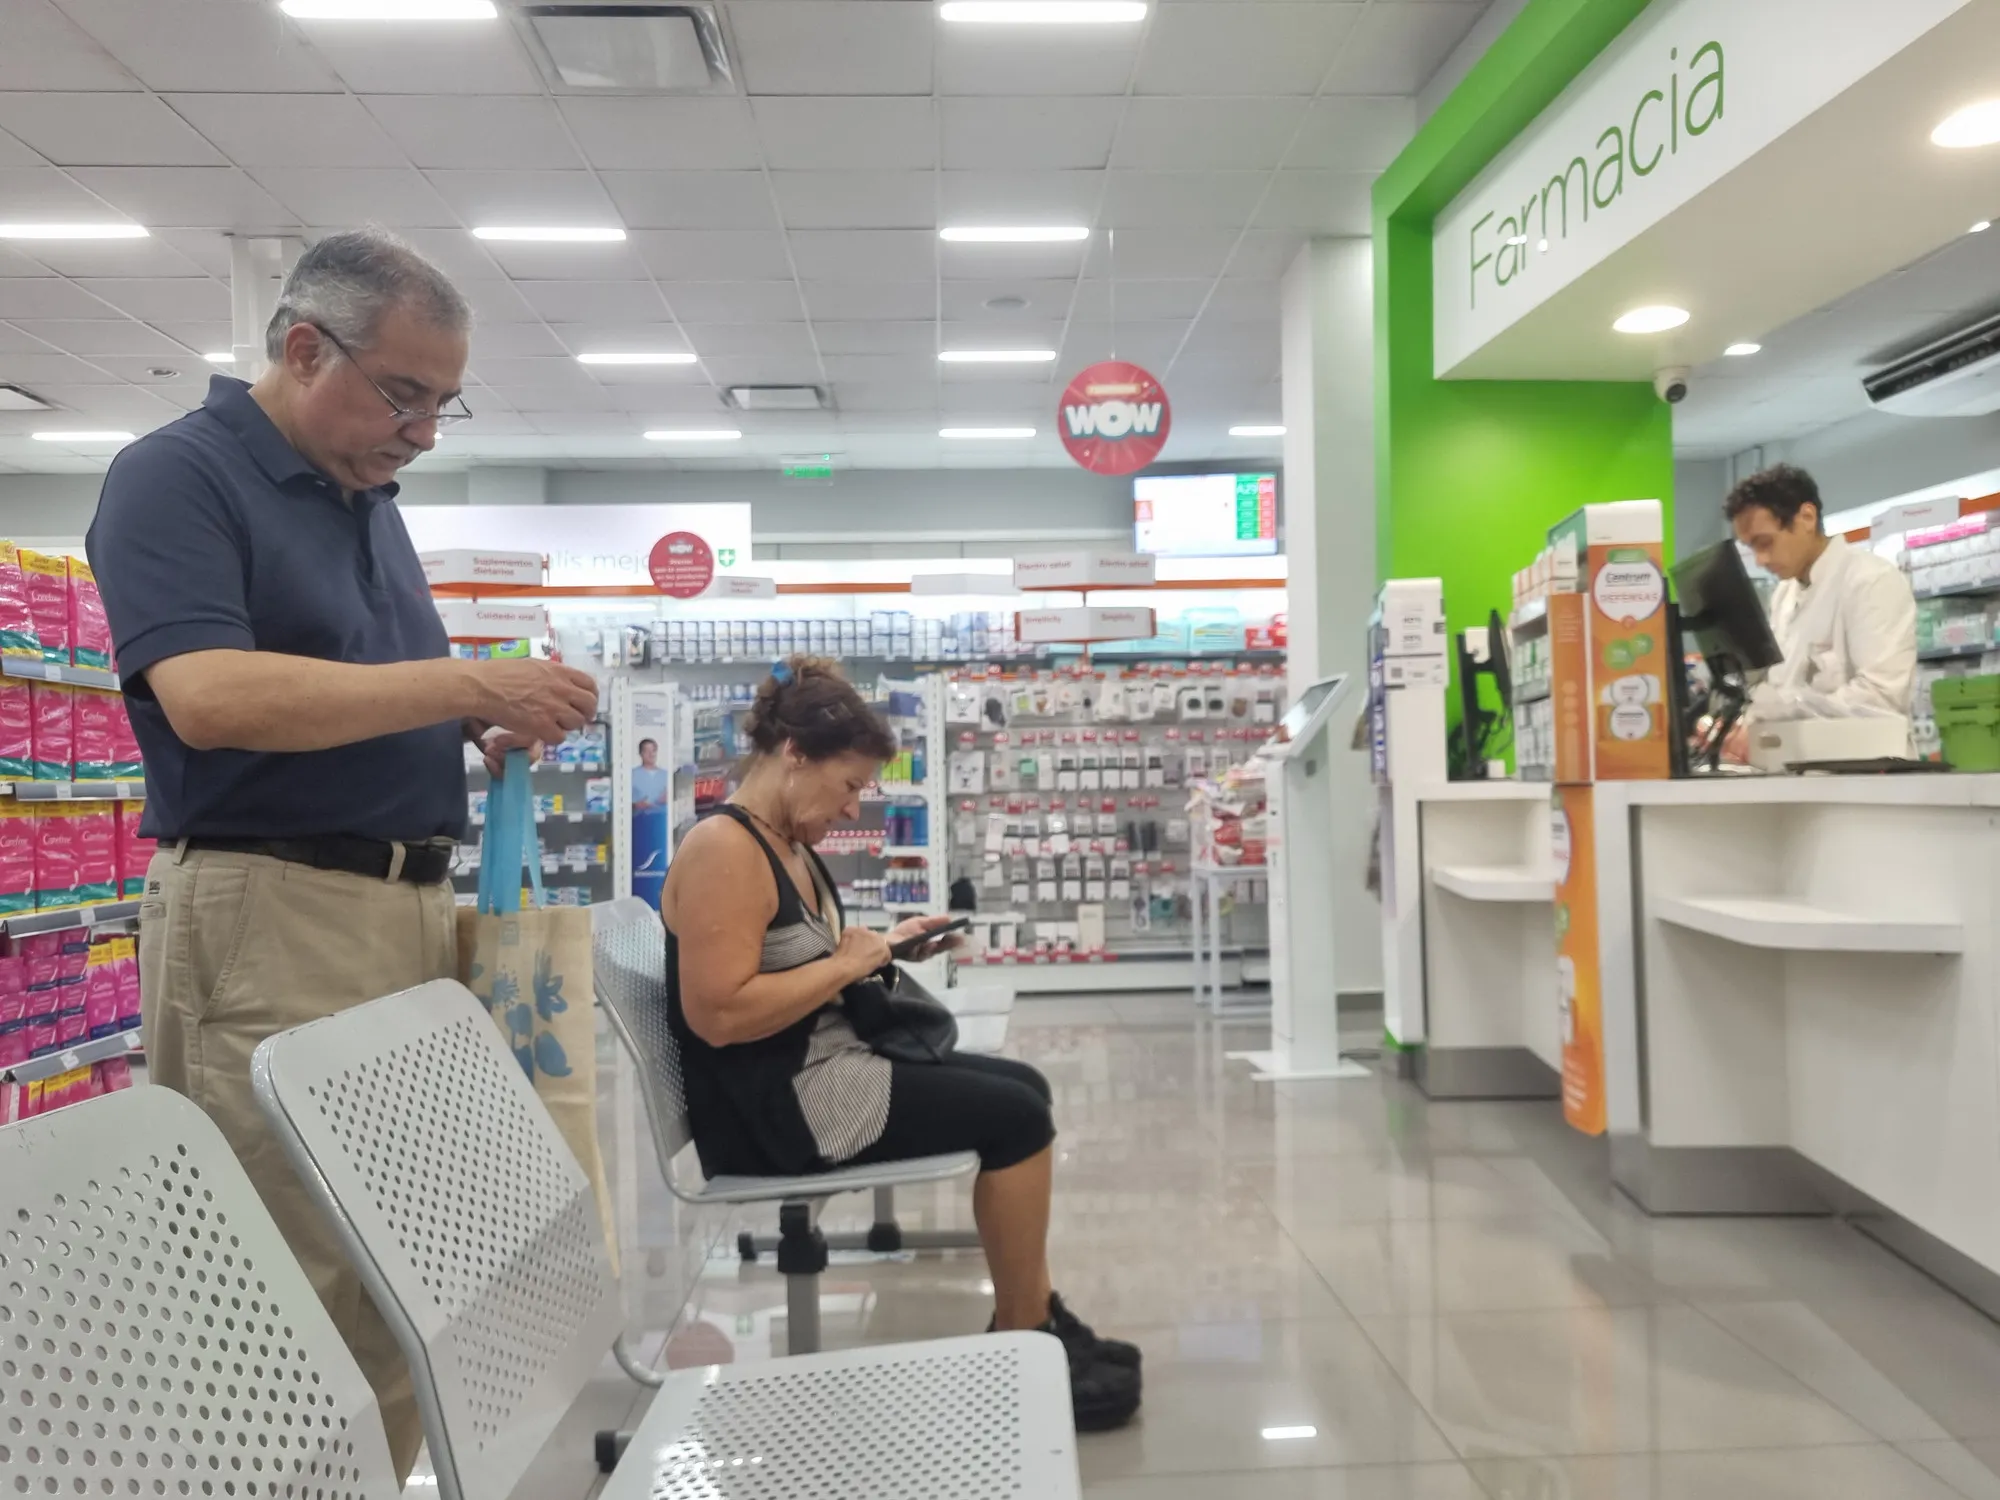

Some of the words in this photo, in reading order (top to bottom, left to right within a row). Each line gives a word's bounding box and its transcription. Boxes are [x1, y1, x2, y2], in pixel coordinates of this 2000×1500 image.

[1471, 40, 1725, 311] Farmacia
[1065, 400, 1162, 439] WOW
[1605, 572, 1651, 583] Centrum
[476, 611, 516, 621] Cuidado
